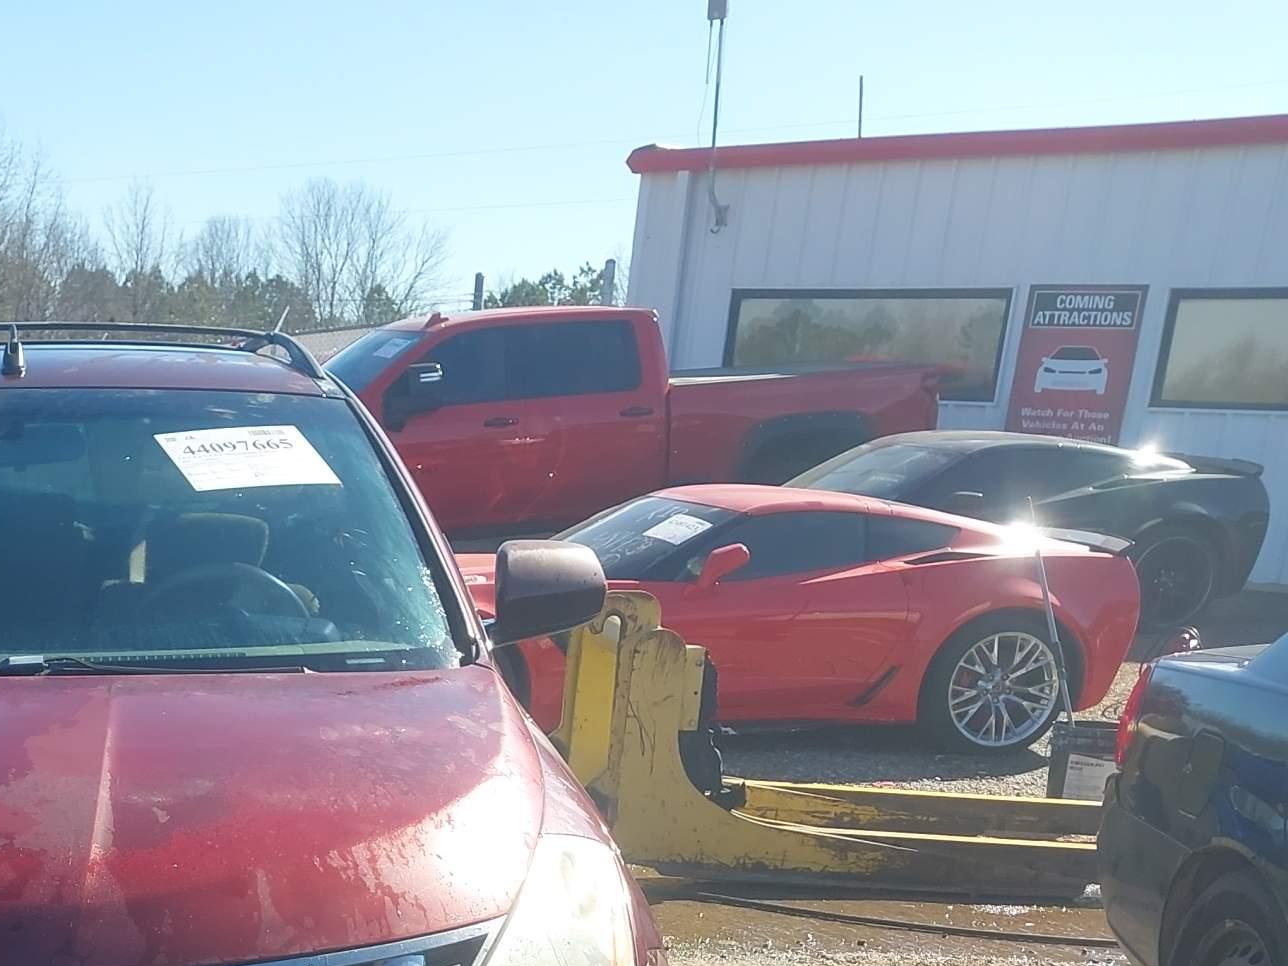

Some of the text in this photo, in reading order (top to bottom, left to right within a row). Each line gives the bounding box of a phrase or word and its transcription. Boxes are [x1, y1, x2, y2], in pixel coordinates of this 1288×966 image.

[1057, 294, 1116, 309] COMING
[1034, 310, 1133, 326] ATTRACTIONS
[1021, 407, 1054, 417] Watch
[1057, 408, 1076, 418] For
[1022, 419, 1105, 432] Vehicles At An
[183, 438, 294, 456] 44097665
